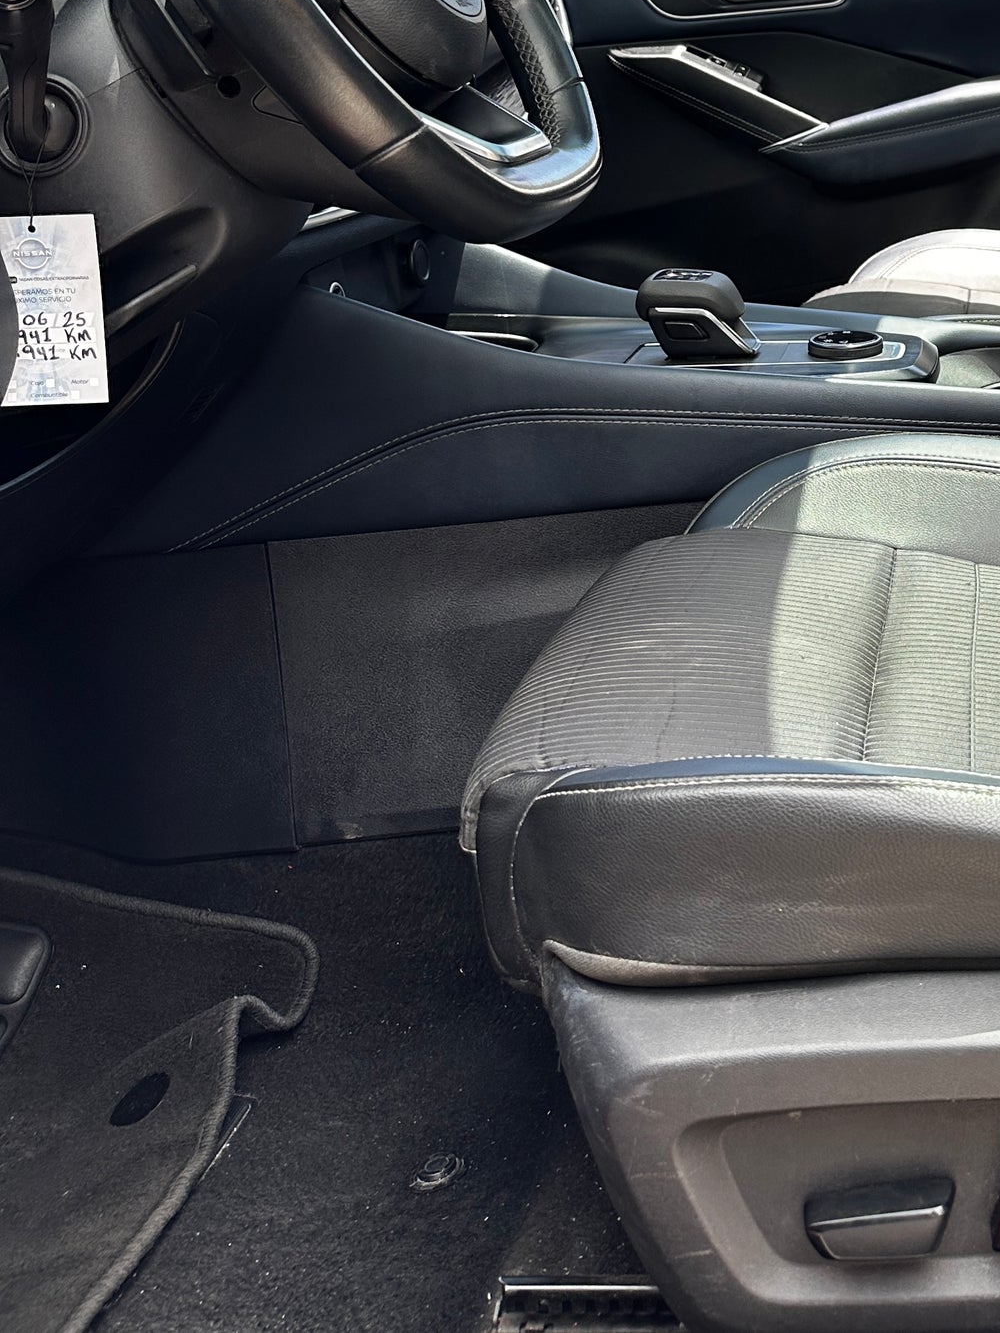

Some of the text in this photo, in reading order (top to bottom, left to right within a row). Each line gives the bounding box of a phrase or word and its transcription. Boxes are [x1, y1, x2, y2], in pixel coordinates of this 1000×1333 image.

[13, 249, 53, 258] NISSAN
[22, 311, 86, 327] 06 25
